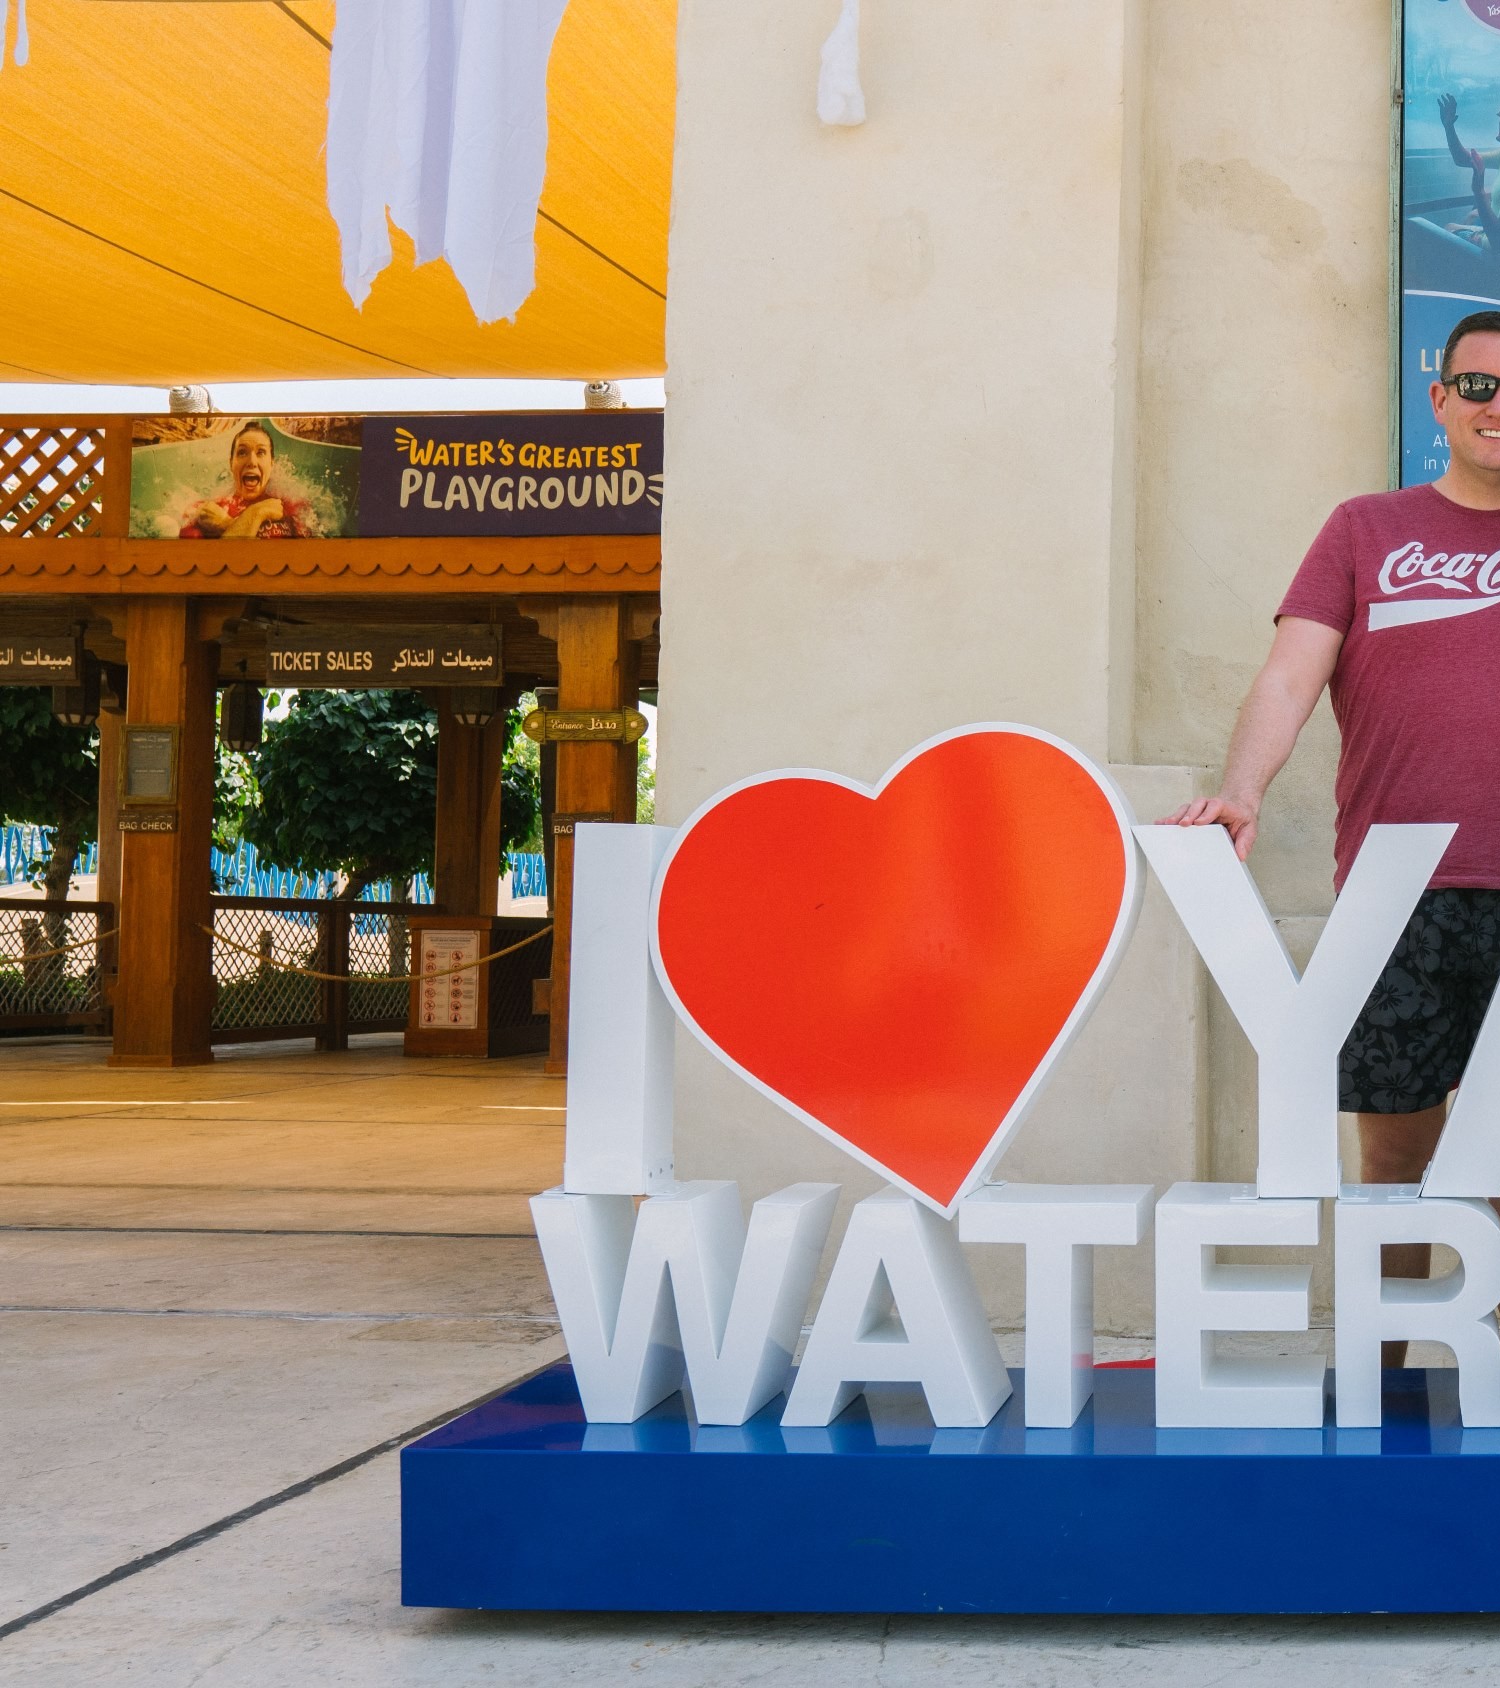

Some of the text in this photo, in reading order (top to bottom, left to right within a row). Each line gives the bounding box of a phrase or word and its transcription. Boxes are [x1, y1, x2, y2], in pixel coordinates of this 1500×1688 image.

[409, 438, 642, 469] WATER'S GREATEST
[1424, 456, 1436, 470] in
[400, 468, 646, 512] PLAYGROUND
[21, 648, 72, 670] مبيعات
[270, 651, 373, 671] TICKET SALES
[391, 648, 493, 672] مبيعات التذاكر
[551, 719, 583, 730] Entrance
[586, 717, 617, 731] مدخل
[119, 822, 173, 830] BAG CHECK
[554, 825, 573, 834] BAG
[564, 822, 672, 1198] I
